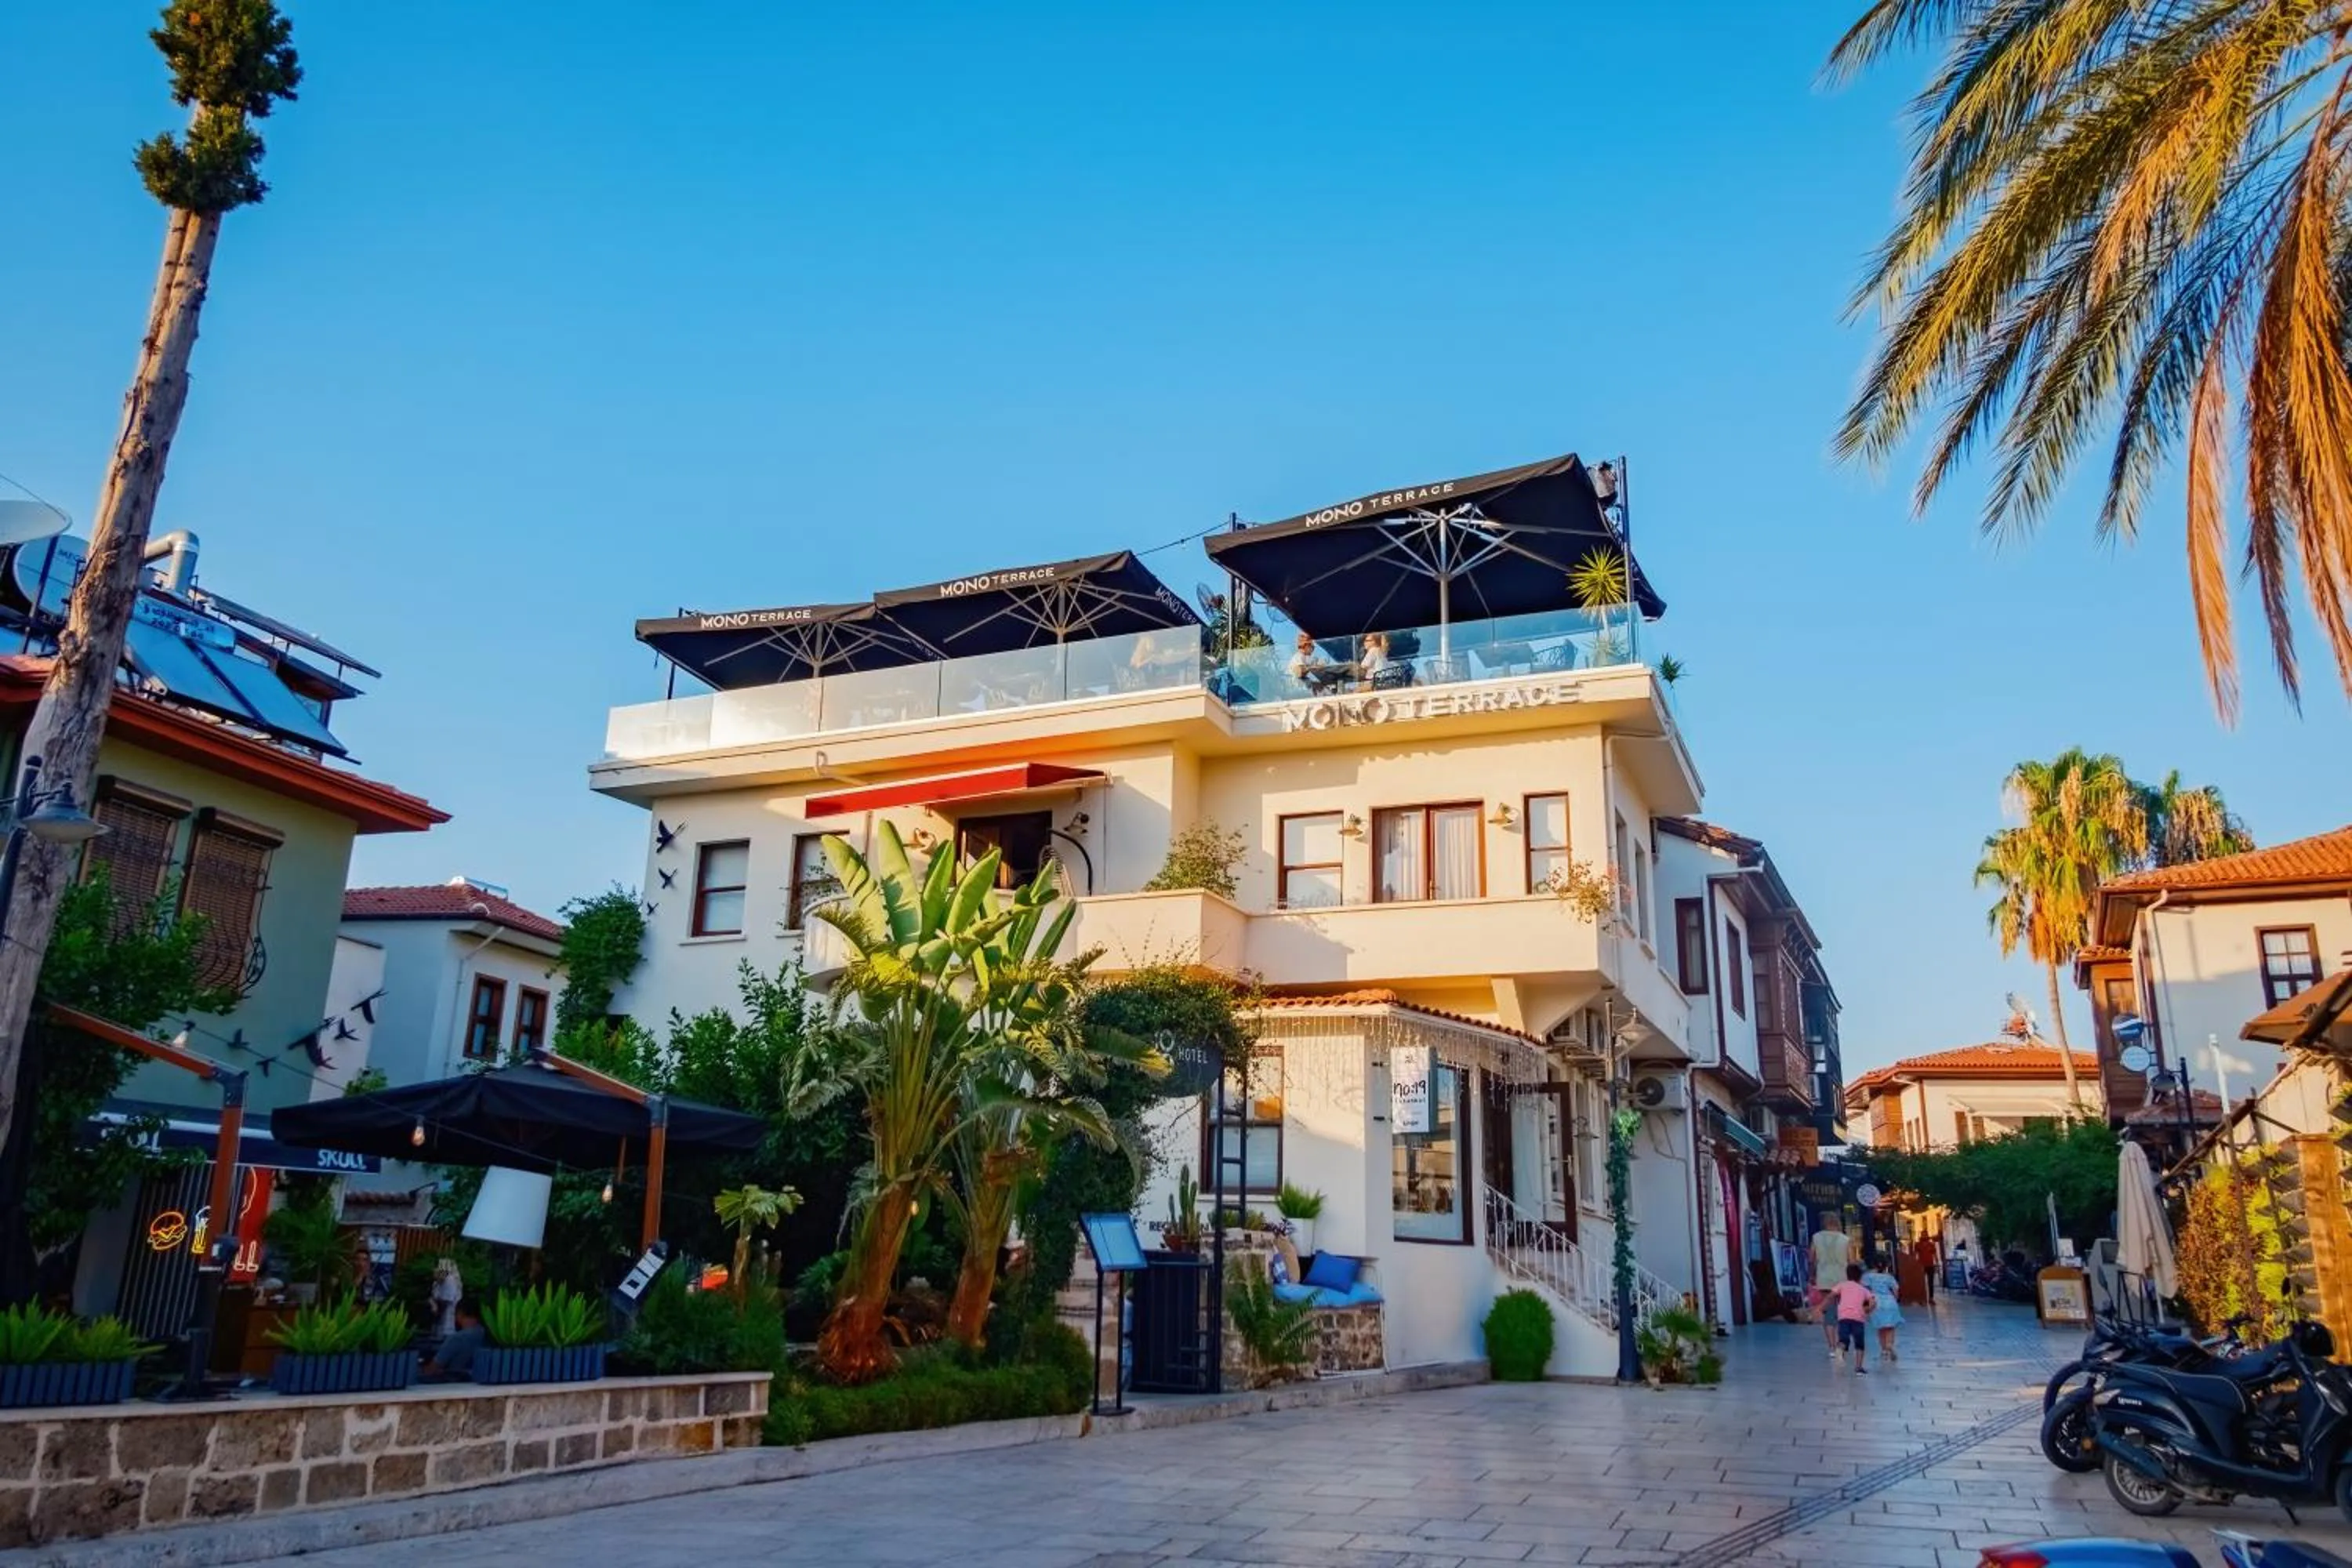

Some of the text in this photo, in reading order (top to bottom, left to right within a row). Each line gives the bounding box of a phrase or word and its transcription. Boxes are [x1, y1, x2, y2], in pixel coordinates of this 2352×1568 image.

[1305, 482, 1454, 528] MONO TERRACE
[941, 567, 1054, 598] MONO TERRACE
[700, 609, 811, 629] MONO TERRACE
[1281, 681, 1581, 734] MONO TERRACE
[1178, 1047, 1208, 1064] HOTEL
[318, 1149, 367, 1170] SKULL
